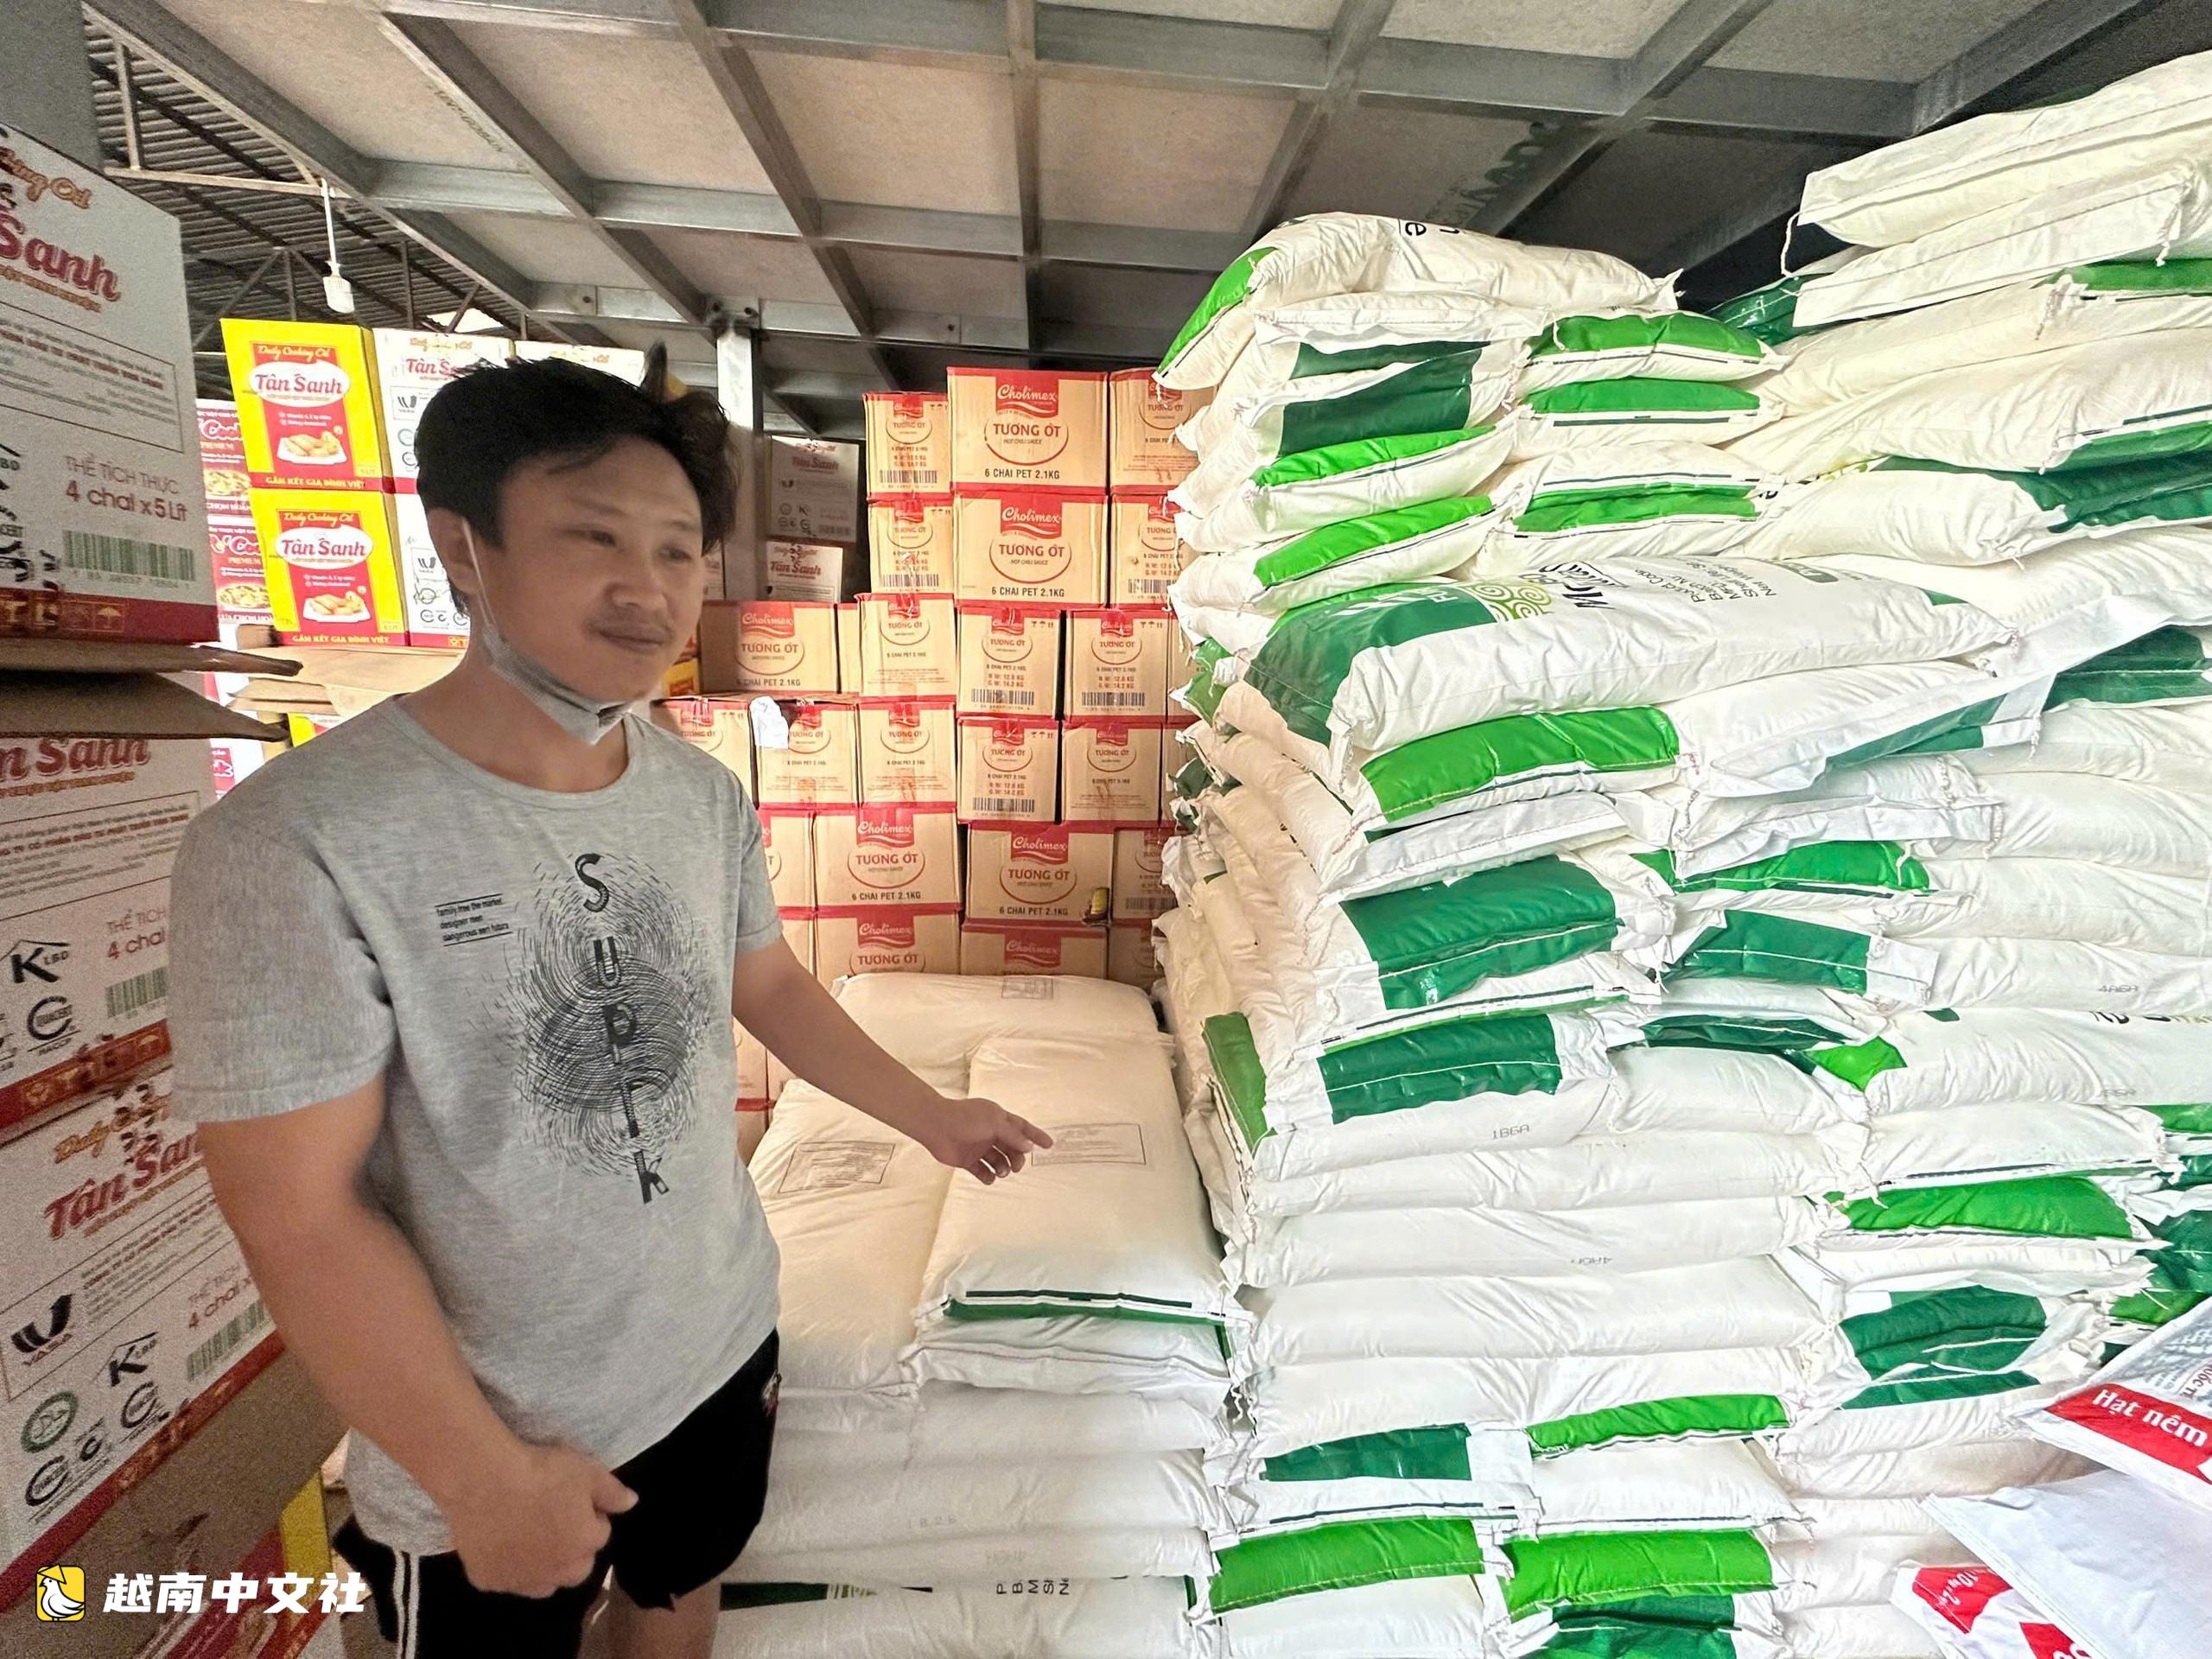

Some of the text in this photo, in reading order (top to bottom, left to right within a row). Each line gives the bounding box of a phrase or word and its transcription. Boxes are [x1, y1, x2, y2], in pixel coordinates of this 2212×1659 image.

[406, 358, 436, 374] Tân
[255, 373, 342, 395] Tân Sanh
[997, 384, 1057, 402] Cholimex
[985, 468, 1060, 480] 6 CHAI PET 2.1KG
[66, 480, 81, 502] 4
[1001, 506, 1060, 524] Cholimex
[282, 538, 315, 556] Tân
[318, 537, 365, 556] Sanh
[1000, 587, 1019, 595] CHAI
[1022, 588, 1038, 596] PET
[1040, 588, 1065, 597] 2.1KG
[742, 613, 792, 625] Cholimex
[858, 822, 912, 835] Cholimex
[1013, 836, 1067, 851] Cholimex
[898, 891, 921, 899] 2.1KG
[1028, 907, 1043, 916] PET
[1046, 907, 1068, 916] 2.1KG
[859, 923, 912, 936] Cholimex
[108, 941, 120, 960] 4
[1006, 940, 1058, 955] Cholimex
[2092, 1389, 2209, 1447] Hạt nêm
